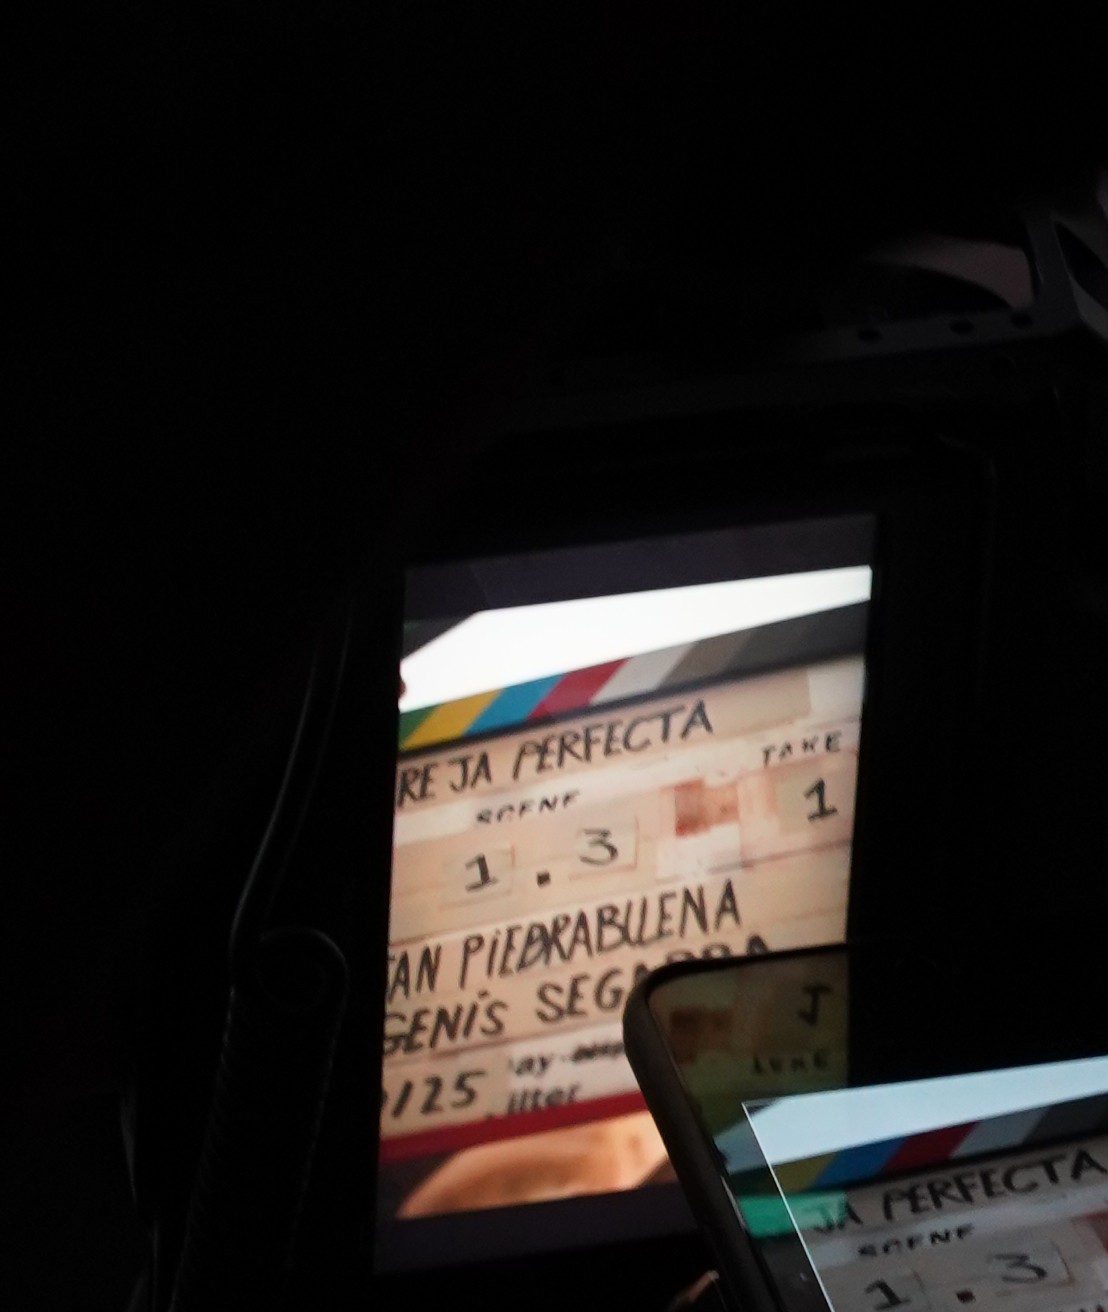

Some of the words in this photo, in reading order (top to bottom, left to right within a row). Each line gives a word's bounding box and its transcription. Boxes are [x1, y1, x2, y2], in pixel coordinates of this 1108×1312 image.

[512, 700, 715, 781] PERFECTA
[804, 779, 839, 825] 1
[383, 943, 443, 1005] AN
[882, 1148, 1108, 1222] PERFECTA
